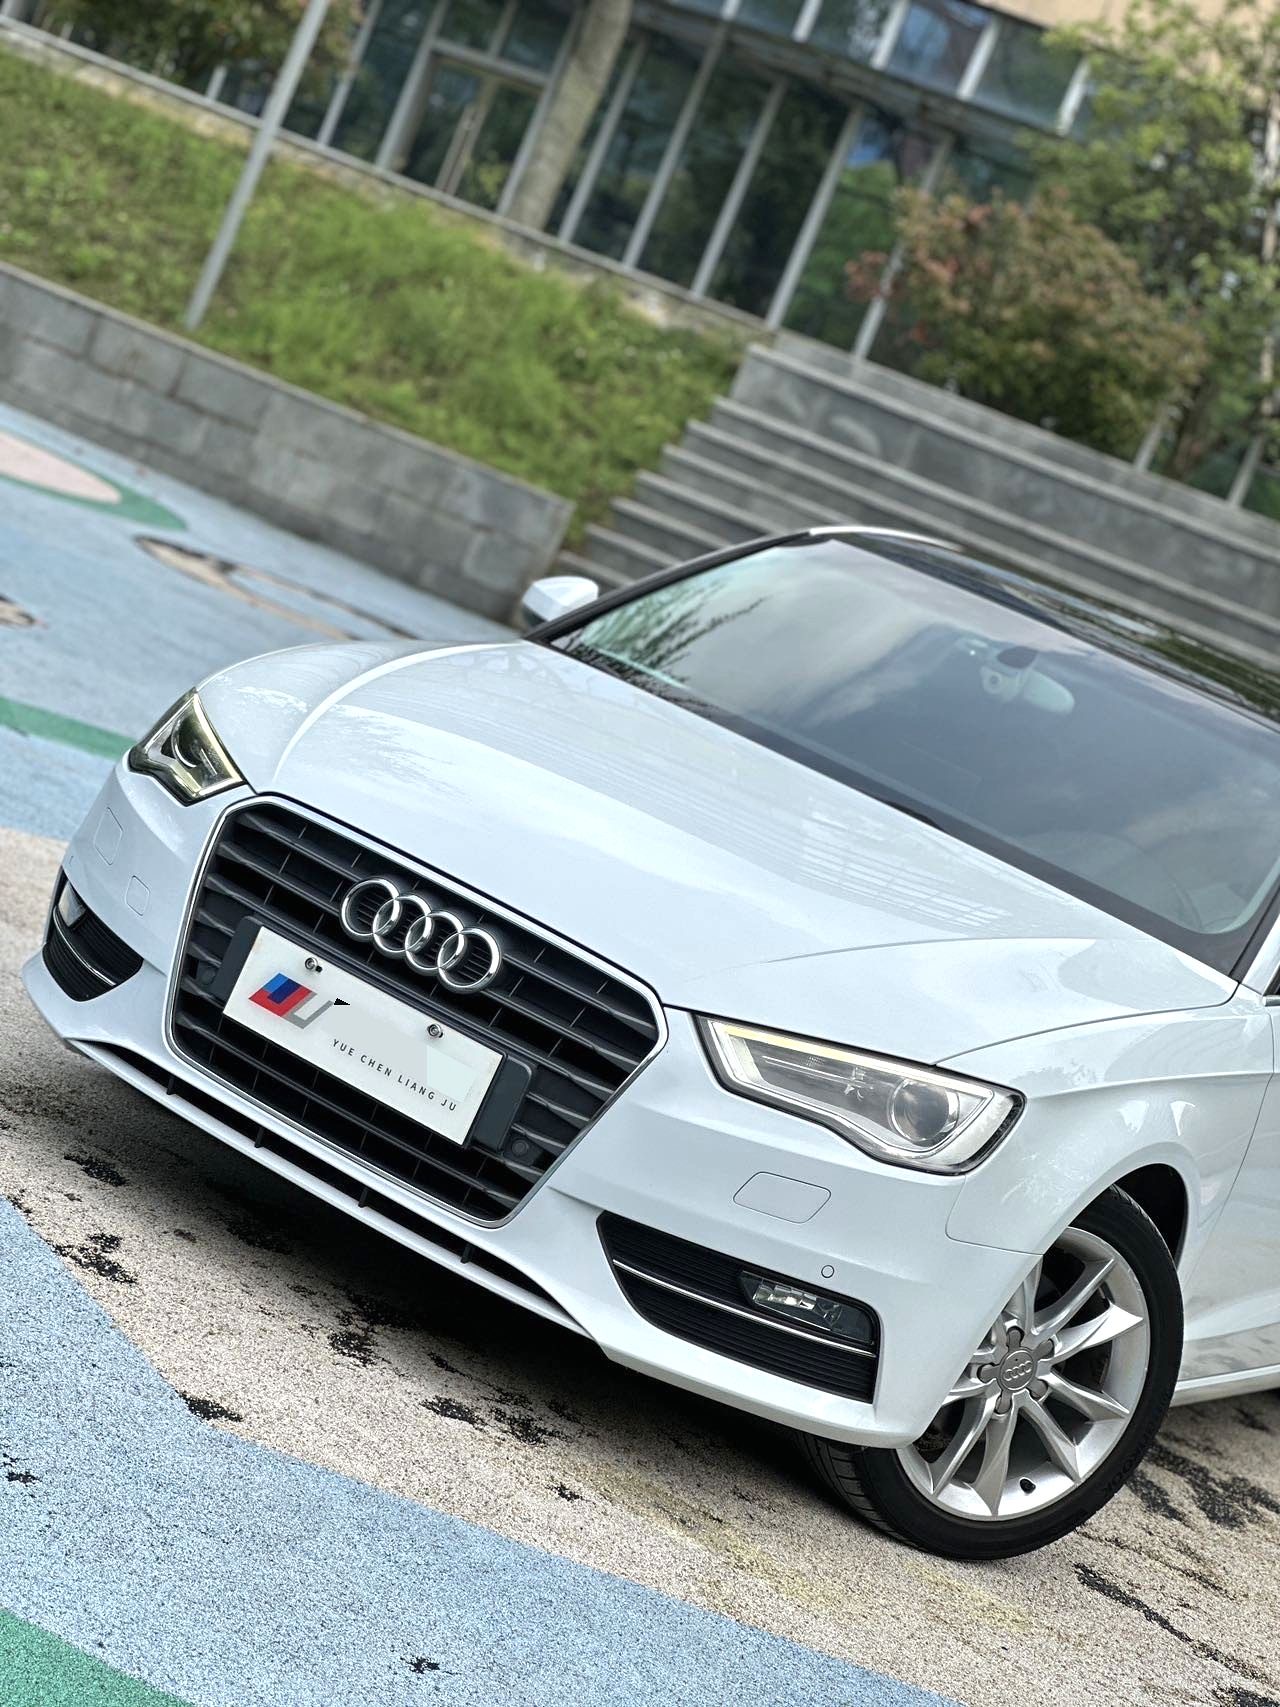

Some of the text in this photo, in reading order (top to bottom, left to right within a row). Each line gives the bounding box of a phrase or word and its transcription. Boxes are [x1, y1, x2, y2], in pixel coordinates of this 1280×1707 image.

[333, 1038, 457, 1111] YUE CHEN LIANG JU
